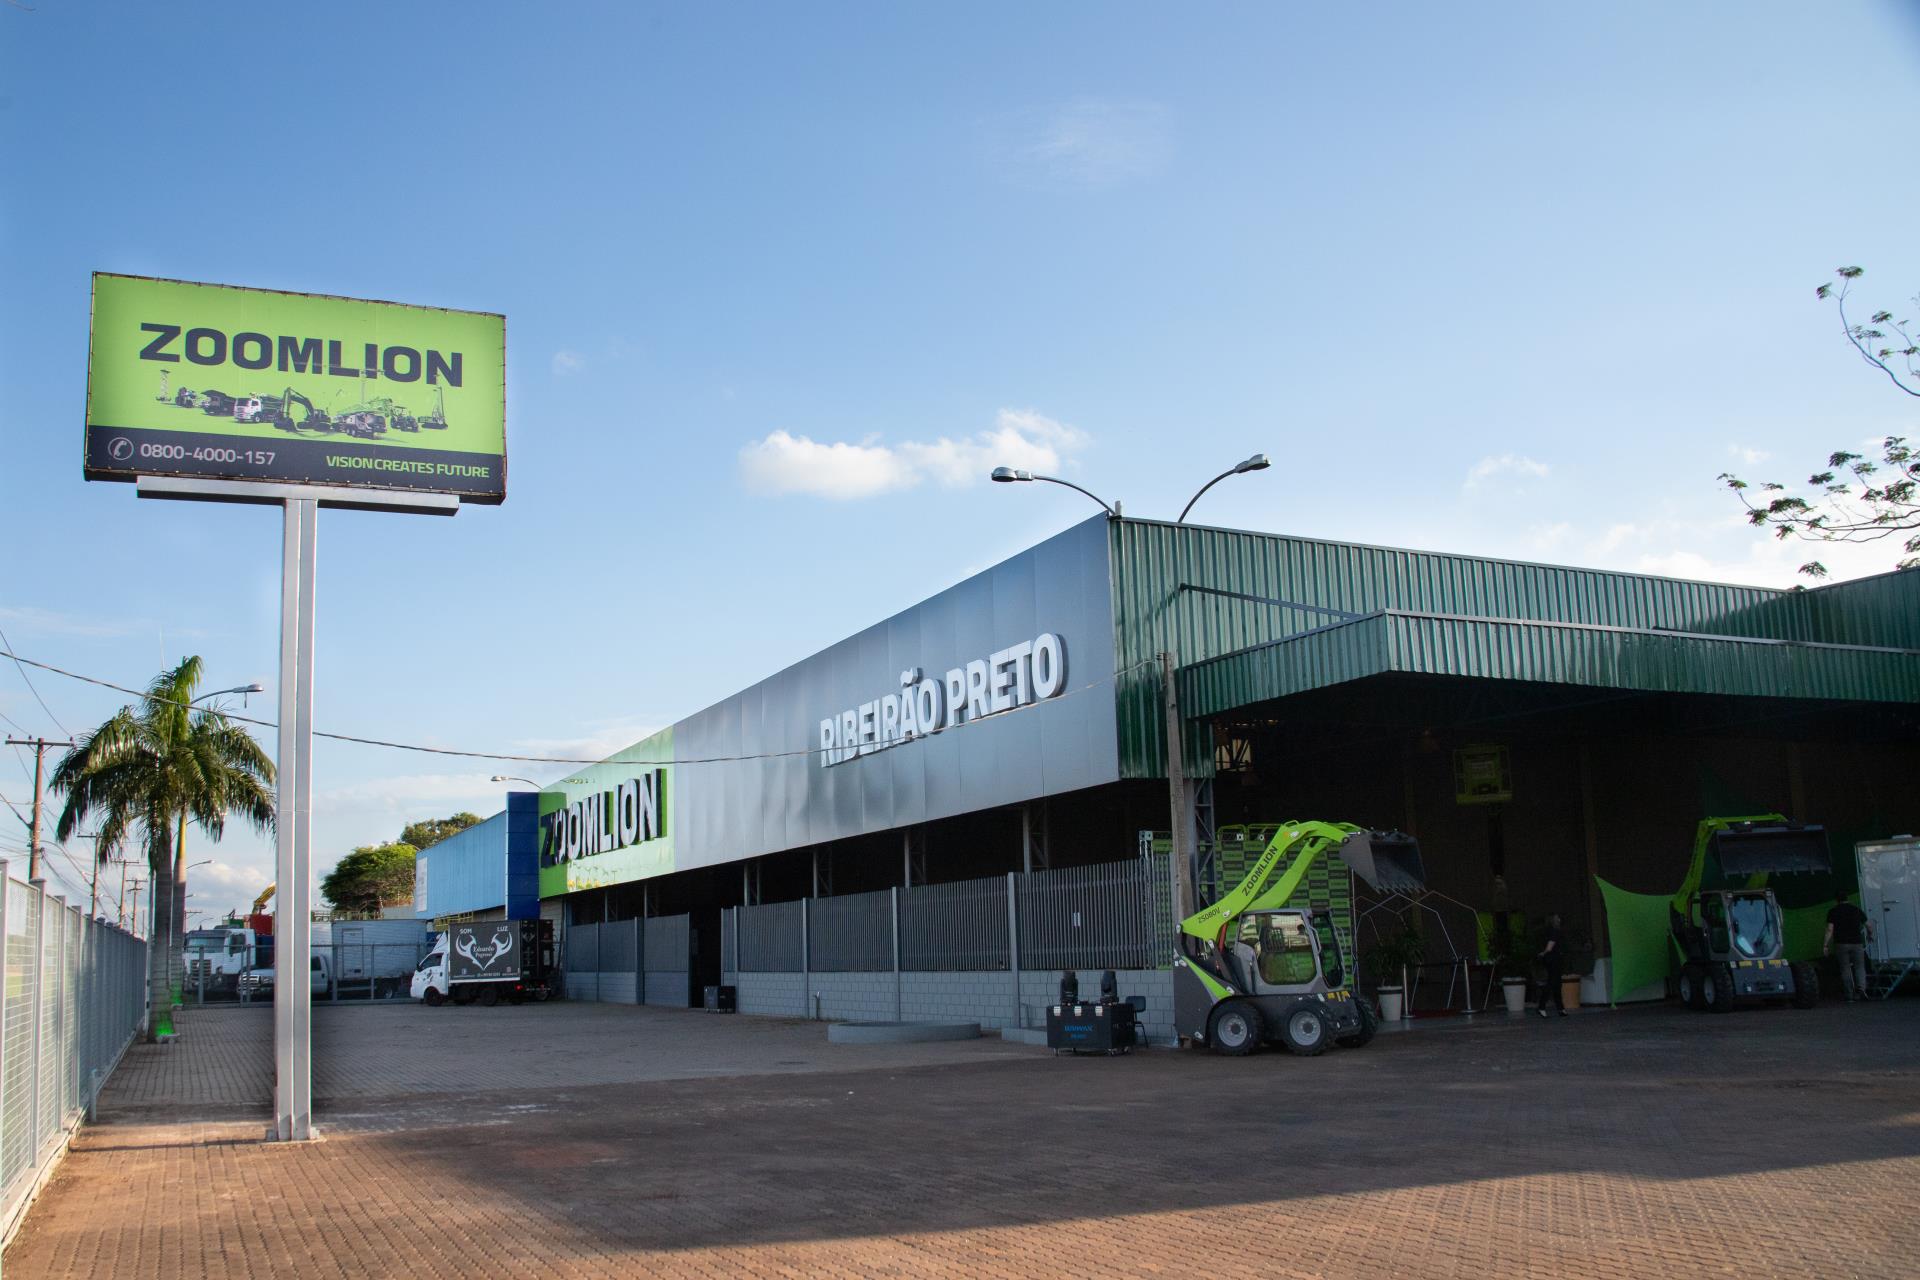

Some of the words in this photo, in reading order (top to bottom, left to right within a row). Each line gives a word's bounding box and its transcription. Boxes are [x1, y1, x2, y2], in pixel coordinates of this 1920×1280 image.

[139, 322, 463, 388] ZOOMLION
[140, 442, 276, 465] 0800-4000-157
[325, 455, 374, 470] VISION
[374, 459, 435, 475] CREATES
[436, 463, 490, 478] FUTURE
[820, 667, 944, 768] RIBEIRÃO
[946, 633, 1064, 728] PRETO
[541, 768, 663, 868] ZOOMLION
[1241, 845, 1278, 896] ZOOMLION
